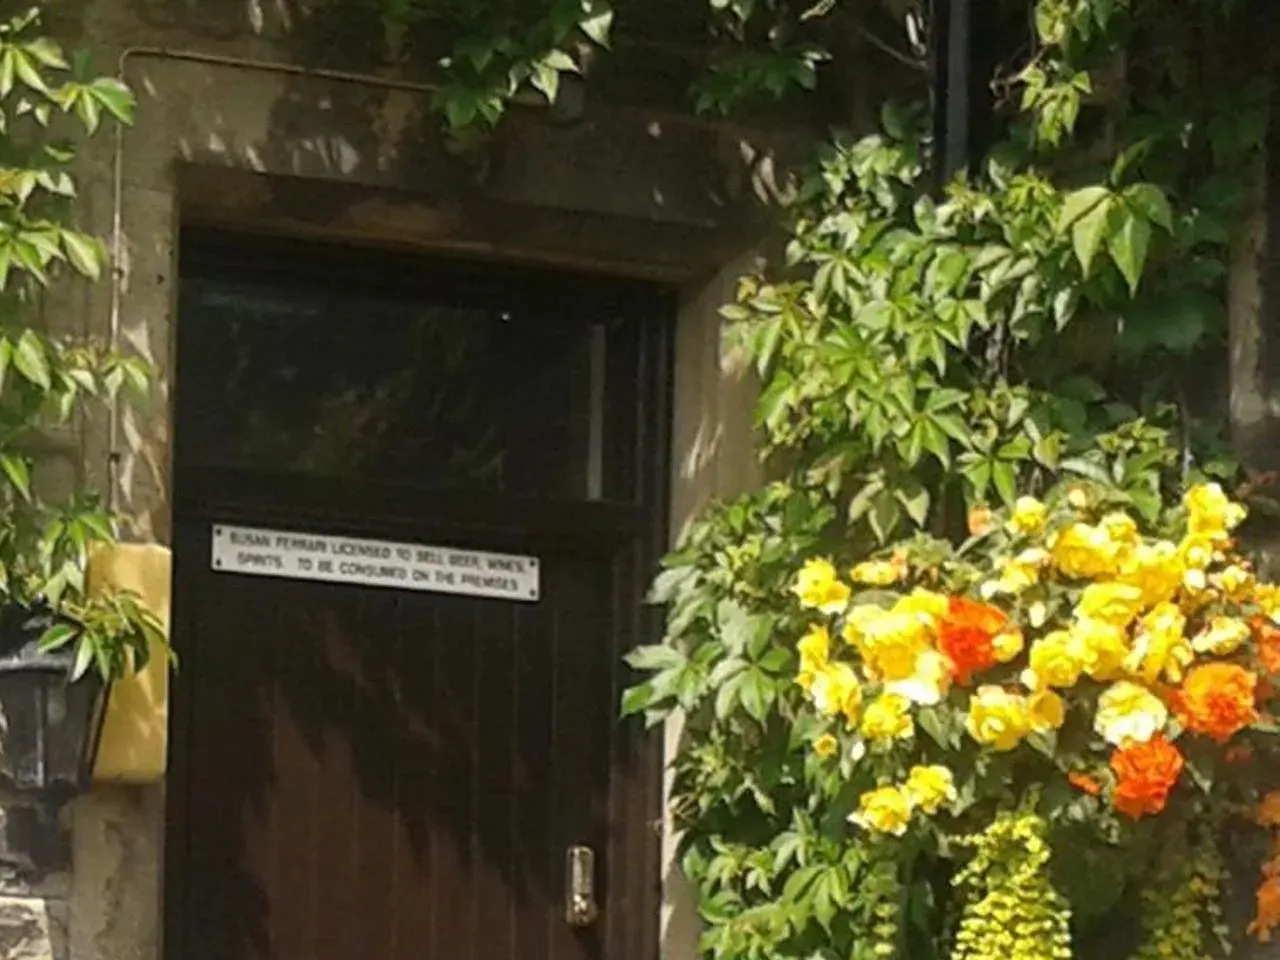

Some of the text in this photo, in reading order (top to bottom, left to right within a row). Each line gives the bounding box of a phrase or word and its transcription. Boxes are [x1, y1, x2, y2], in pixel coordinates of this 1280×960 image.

[332, 542, 392, 559] LICENSED
[397, 547, 412, 561] TO
[417, 550, 444, 565] SELL
[297, 556, 313, 571] TO
[318, 560, 333, 574] BE
[339, 561, 408, 580] CONSUMED
[412, 568, 430, 582] ON
[435, 570, 455, 585] THE
